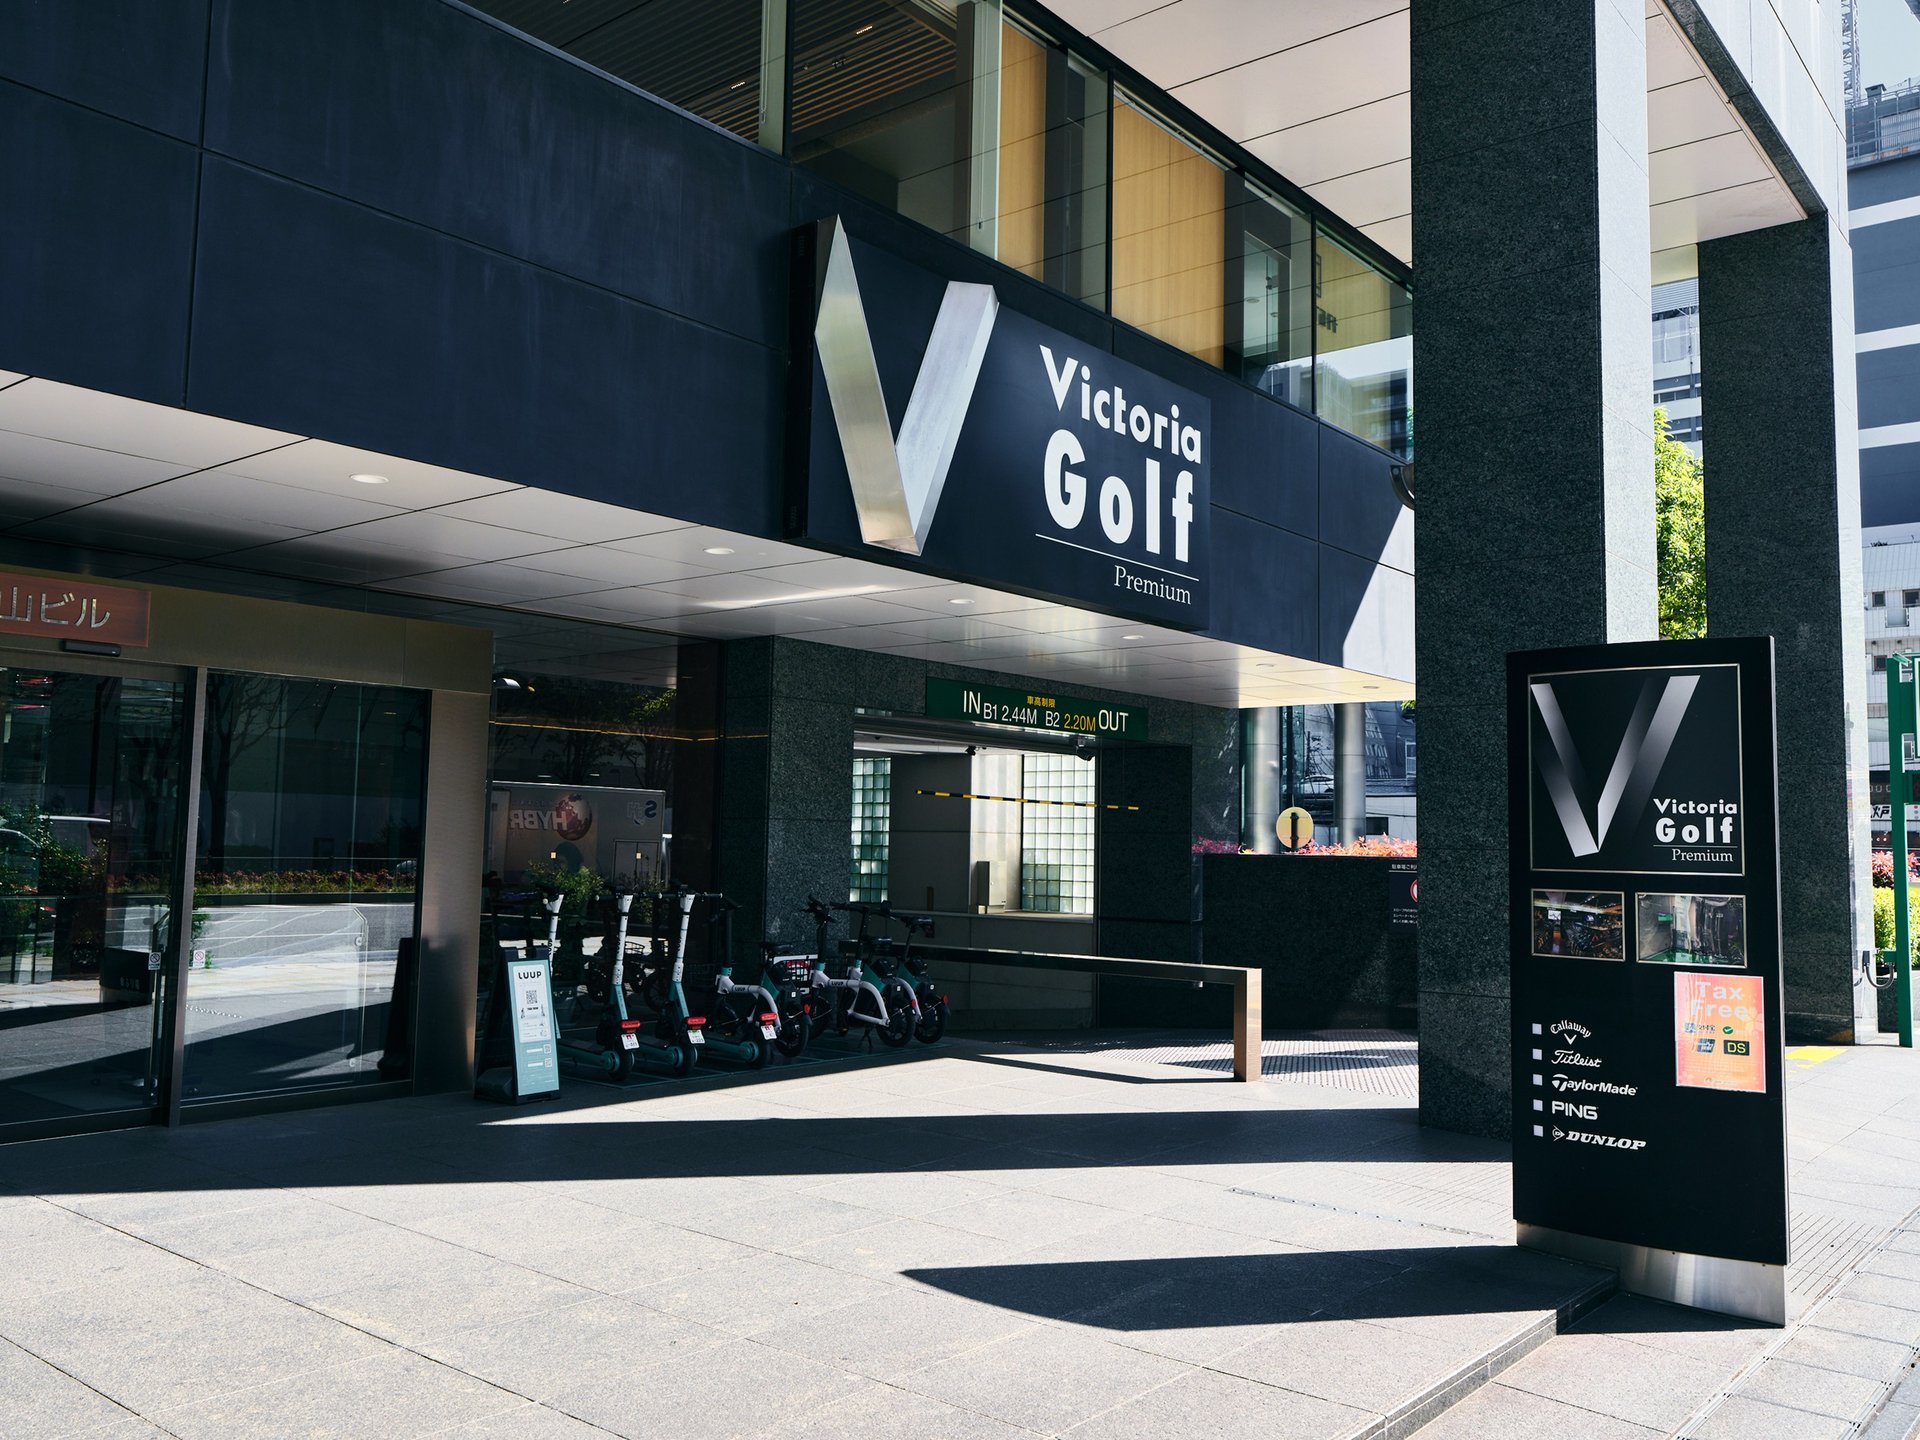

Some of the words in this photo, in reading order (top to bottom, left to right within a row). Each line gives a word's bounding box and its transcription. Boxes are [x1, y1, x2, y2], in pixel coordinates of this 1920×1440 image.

[1039, 344, 1202, 464] Victoria
[1044, 429, 1194, 562] Golf
[1114, 565, 1192, 605] Premium
[963, 690, 981, 714] IN
[984, 703, 998, 720] B1
[1002, 705, 1038, 725] 2.44M
[1046, 710, 1060, 728] B2
[1064, 713, 1096, 732] 2.20M
[1098, 709, 1129, 732] OUT
[1027, 695, 1056, 708] 車高制限
[1653, 798, 1738, 815] Victoria
[1655, 817, 1734, 844] Golf
[1672, 848, 1733, 862] Premium
[518, 971, 542, 980] LUUP
[1696, 981, 1743, 1001] Tax
[1692, 999, 1749, 1019] Free
[1550, 1019, 1592, 1039] Callaway
[1551, 1049, 1602, 1068] Titleist
[1552, 1073, 1637, 1096] TaylorMade
[1552, 1100, 1598, 1120] PING
[1566, 1130, 1647, 1150] DUNLOP
